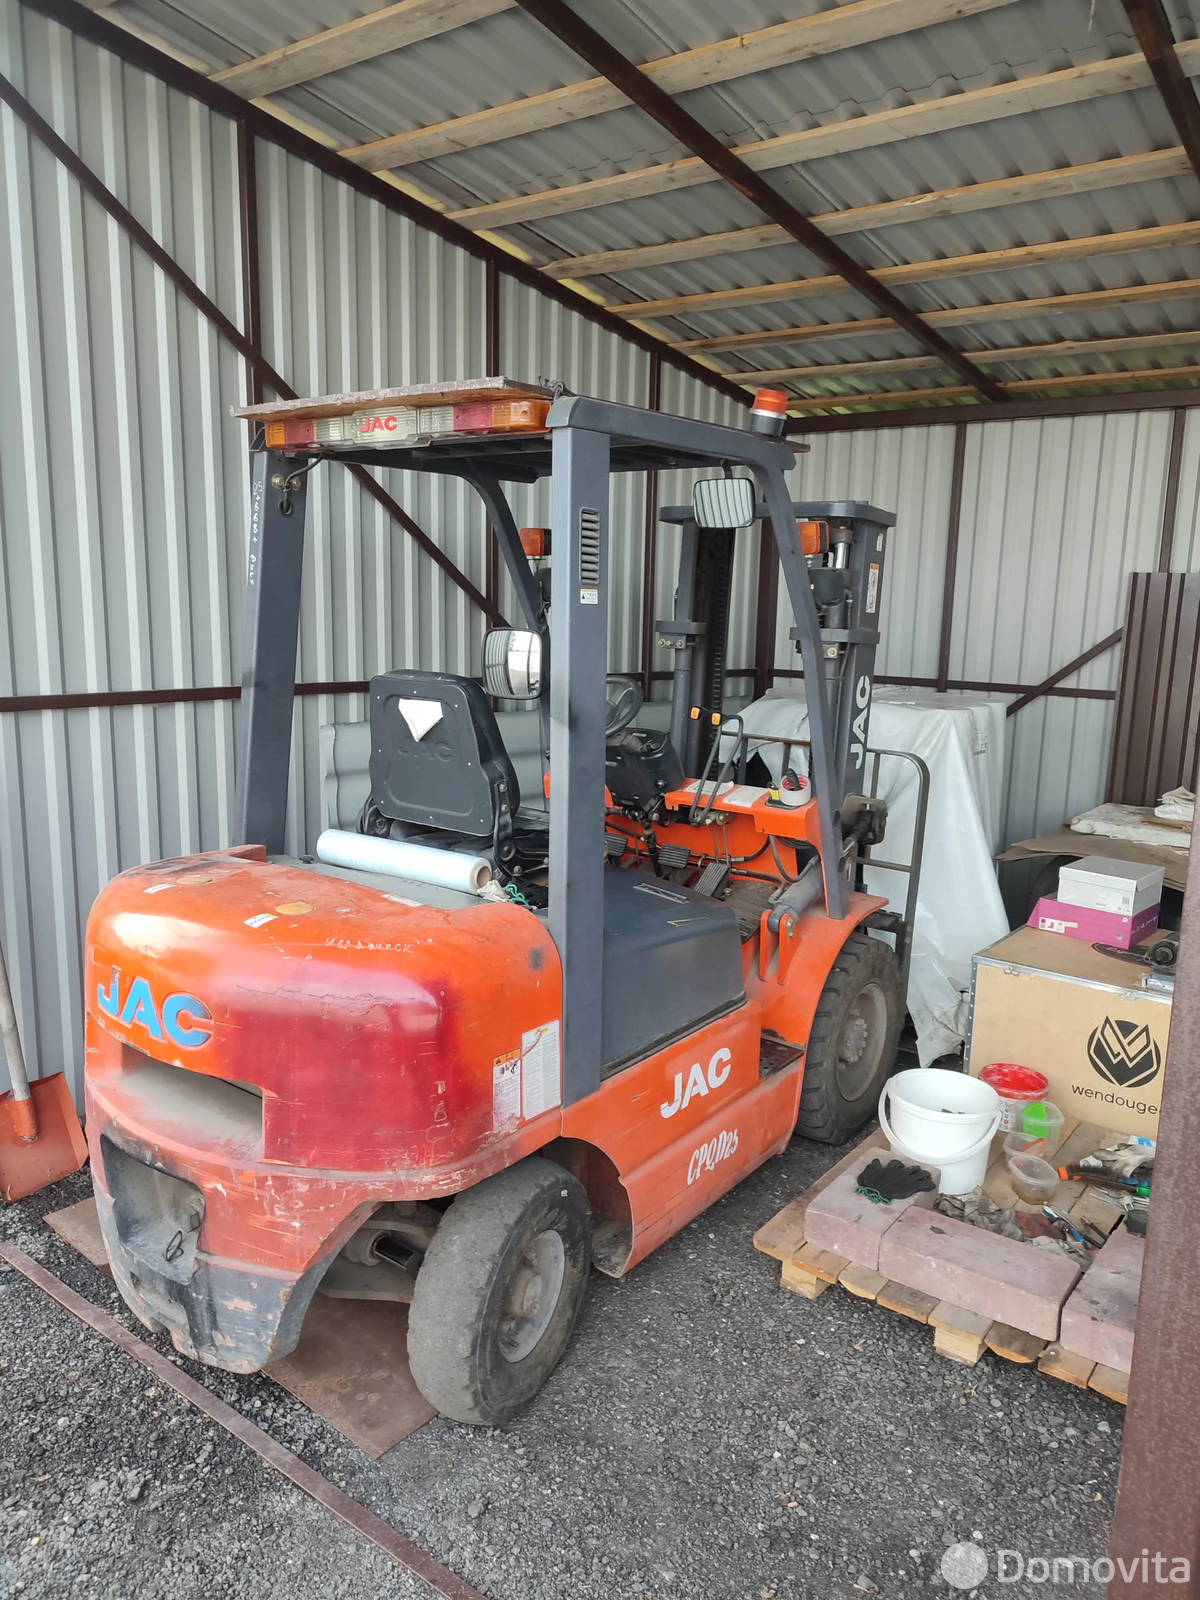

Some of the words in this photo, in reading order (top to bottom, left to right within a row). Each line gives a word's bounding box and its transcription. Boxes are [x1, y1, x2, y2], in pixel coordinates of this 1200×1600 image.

[360, 416, 397, 432] JAC
[397, 737, 453, 762] JAC
[850, 675, 871, 770] JAC
[97, 966, 214, 1049] JAC
[660, 1048, 732, 1119] JAC
[1071, 1084, 1160, 1115] wendouge
[687, 1129, 739, 1186] CPQD25
